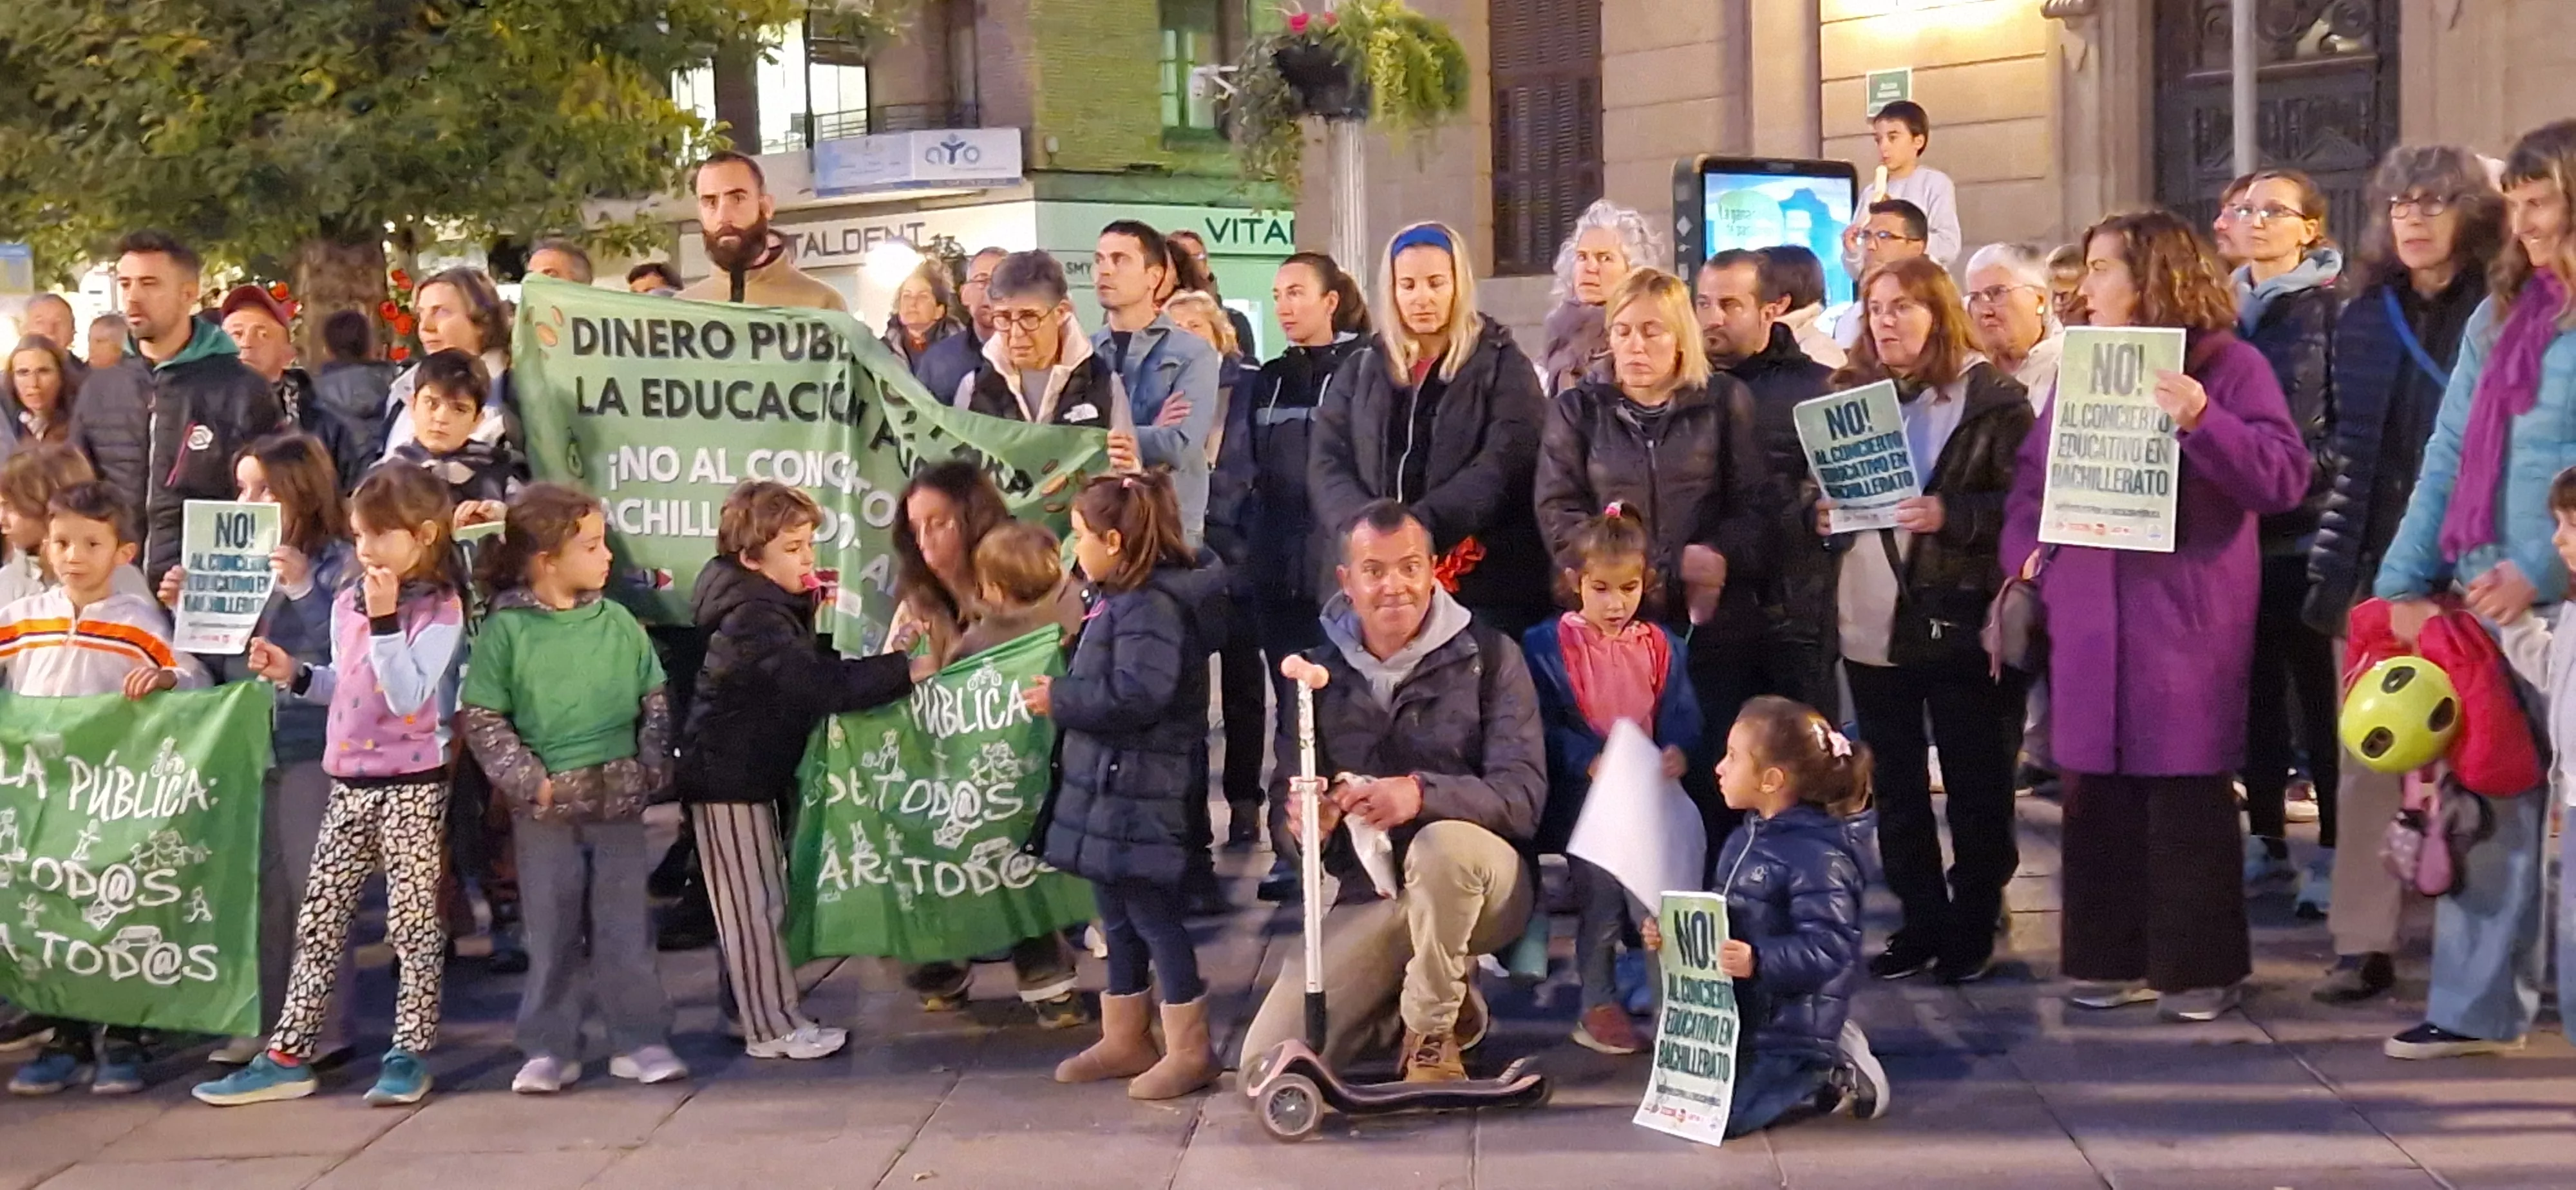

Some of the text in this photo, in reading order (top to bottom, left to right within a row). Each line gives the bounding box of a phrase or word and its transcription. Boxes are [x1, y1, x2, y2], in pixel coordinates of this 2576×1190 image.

[573, 317, 735, 359] DINERO
[2089, 342, 2145, 396] NO!
[576, 377, 629, 417] LA
[2060, 401, 2078, 428] AL
[1824, 398, 1873, 441] NO!
[608, 446, 680, 491] ¡NO
[689, 448, 737, 484] AL
[2145, 437, 2170, 464] EN
[213, 511, 256, 549] NO!
[65, 750, 218, 822] PÚBLICA:
[34, 930, 219, 987] TOD@S
[1672, 909, 1718, 971] NO!
